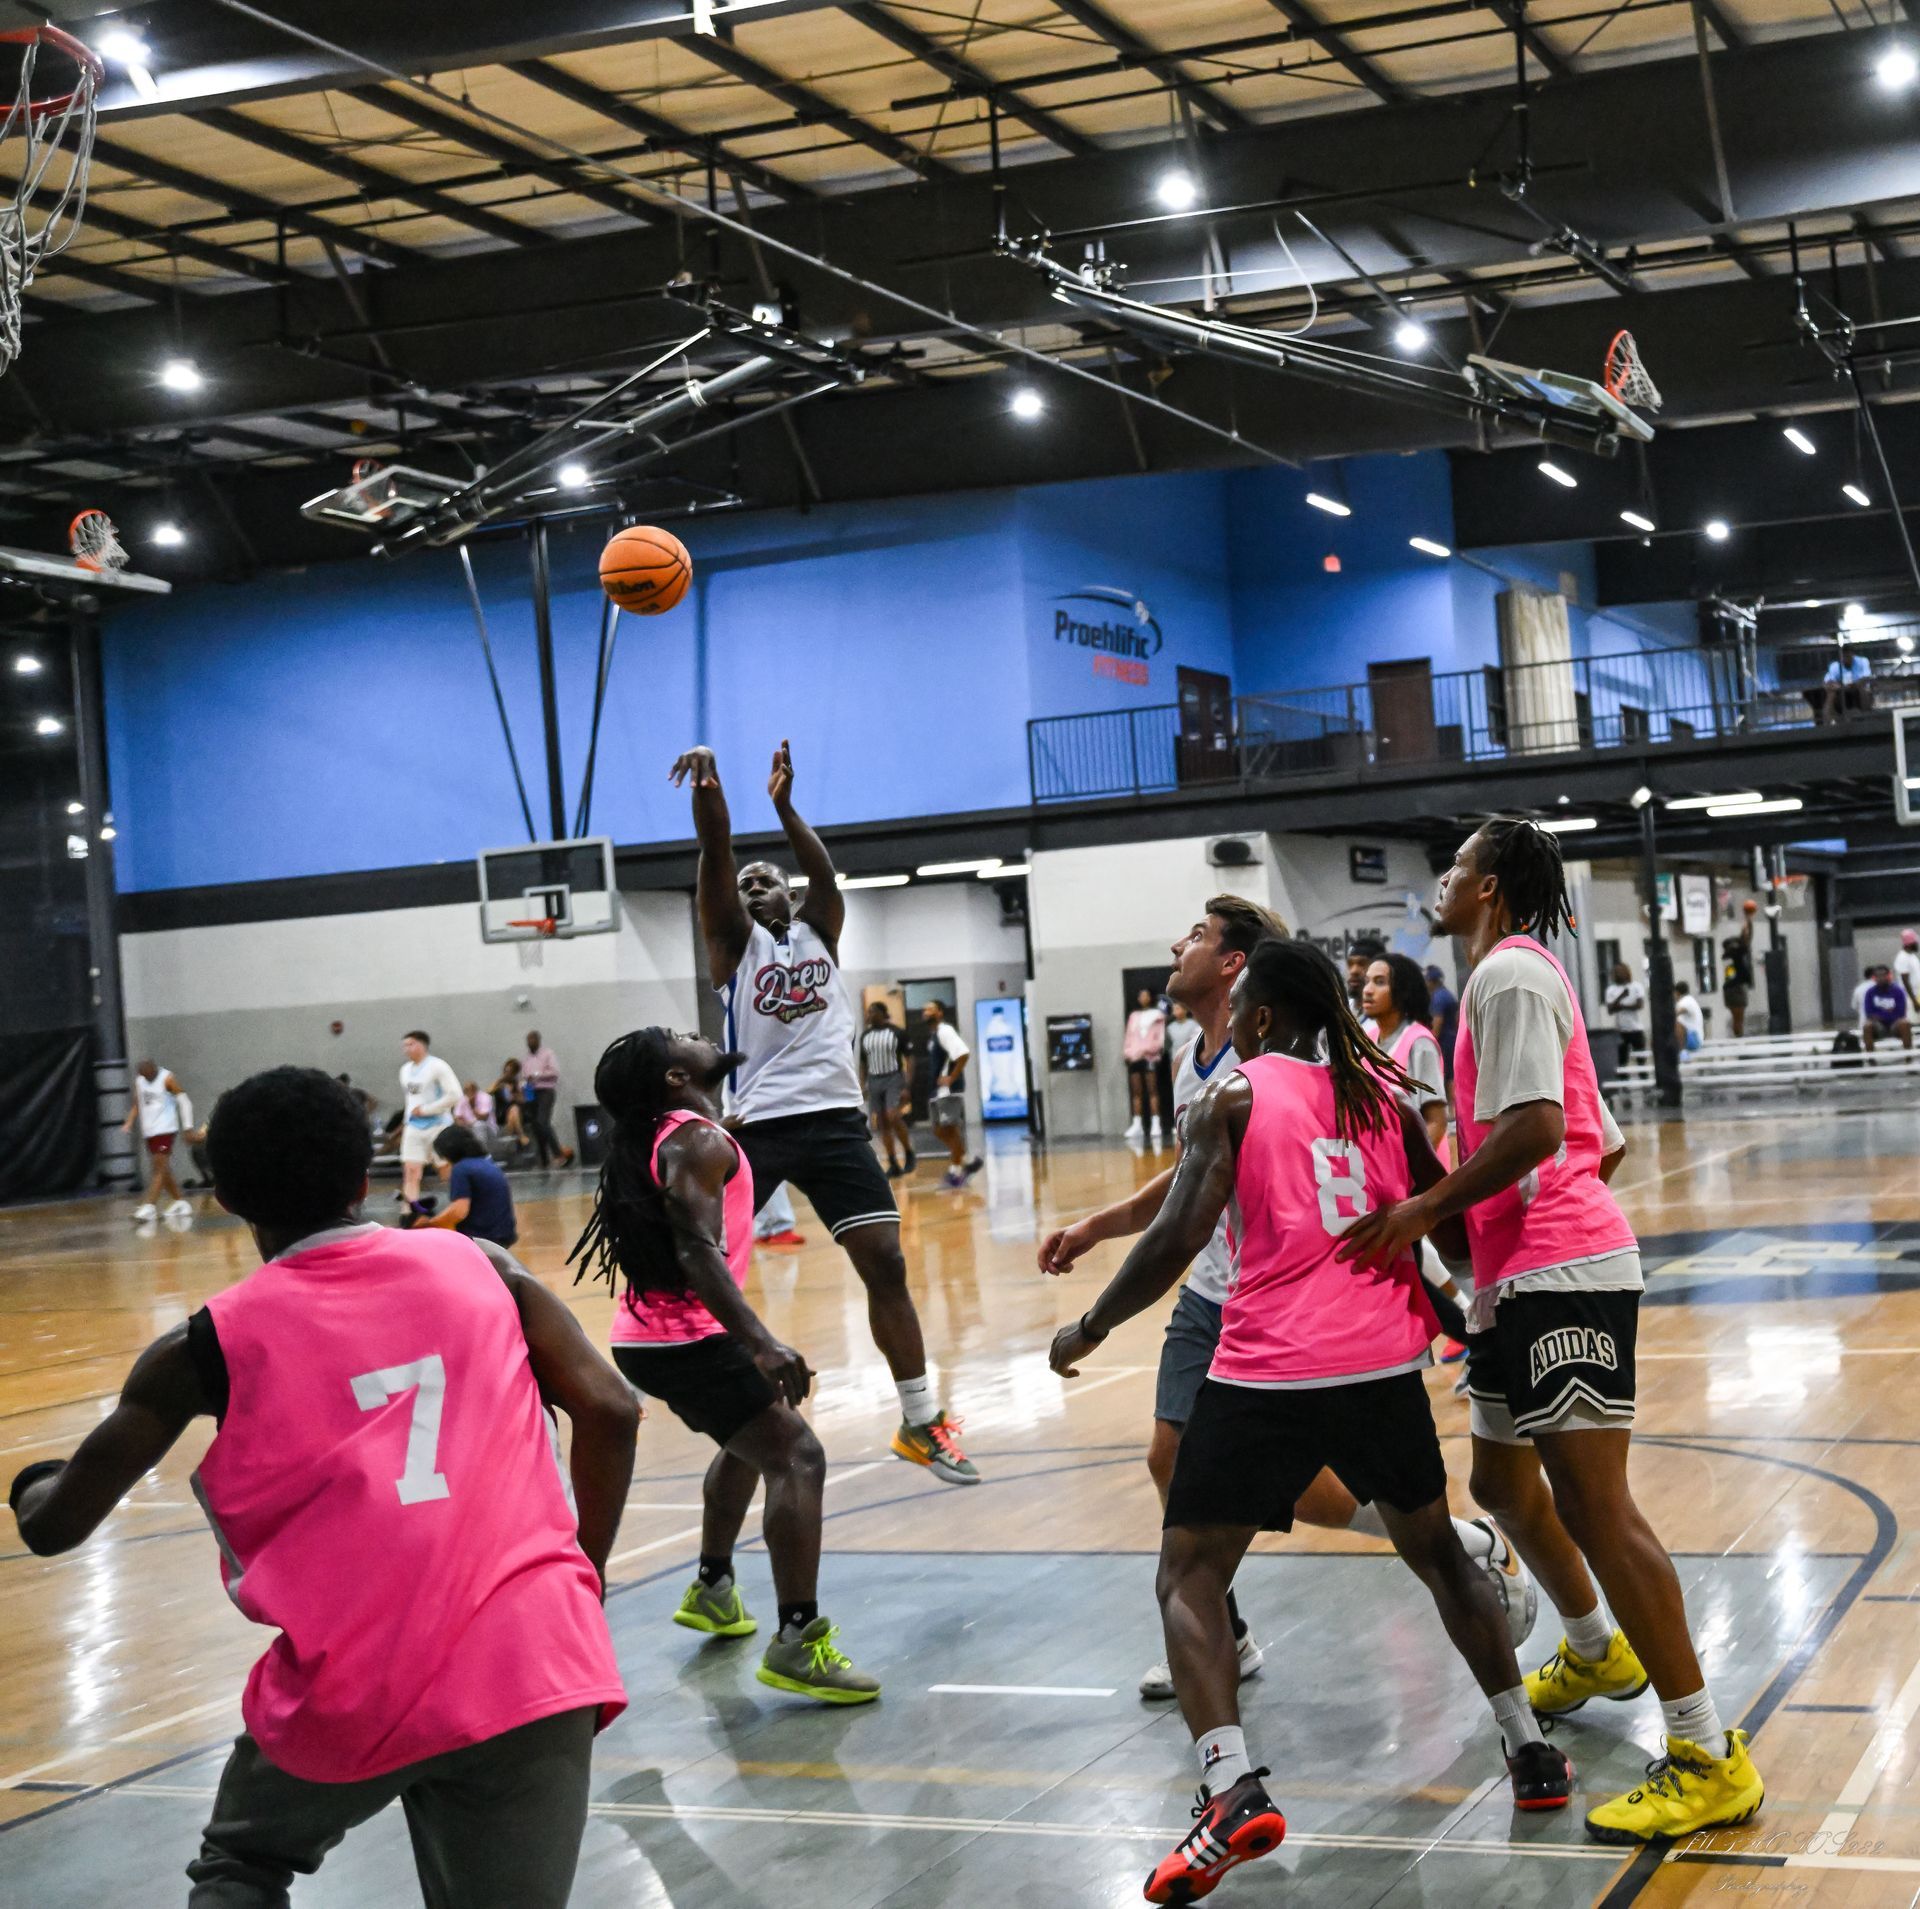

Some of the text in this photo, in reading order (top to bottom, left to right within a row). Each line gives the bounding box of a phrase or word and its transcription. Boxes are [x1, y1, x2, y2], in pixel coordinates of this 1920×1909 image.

[1055, 609, 1150, 660] Proehlific
[754, 958, 831, 1016] Drew
[1310, 1138, 1368, 1237] 8
[1530, 1326, 1618, 1389] ADIDAS
[350, 1354, 451, 1506] 7
